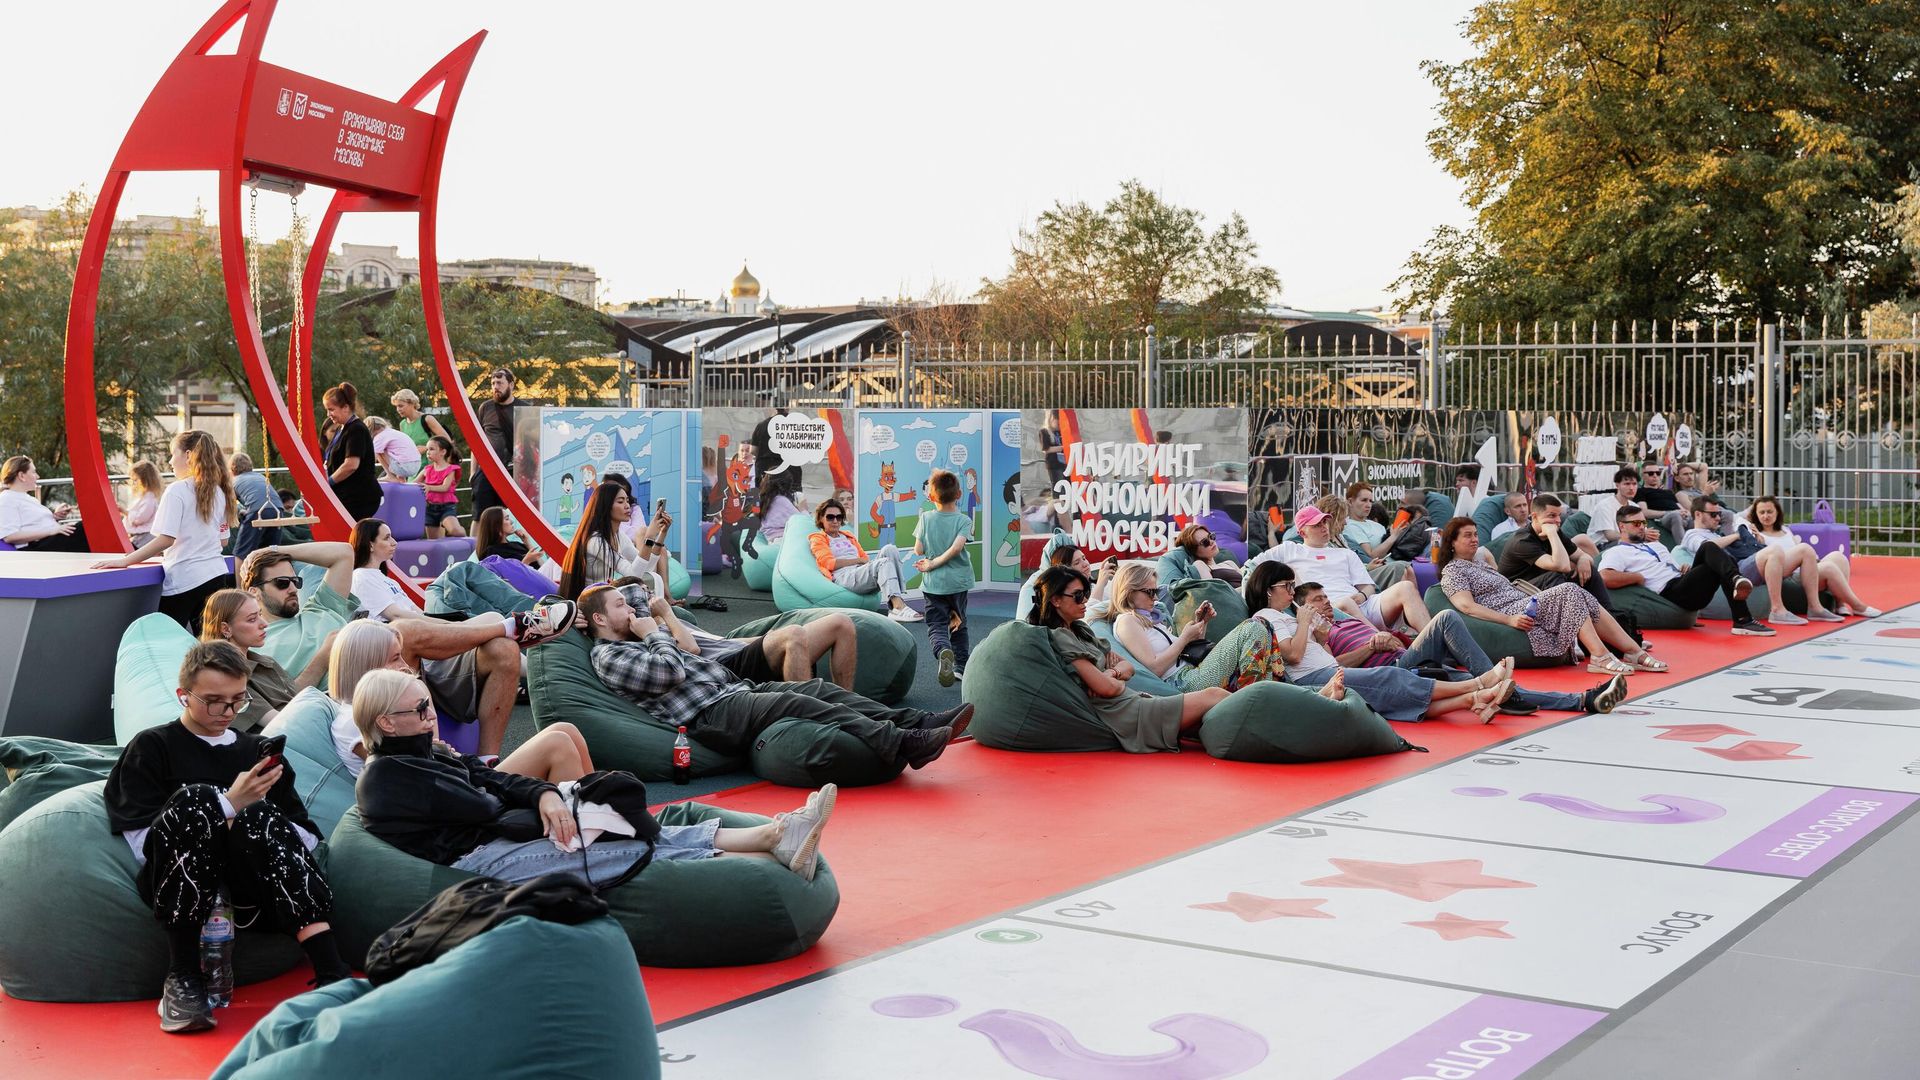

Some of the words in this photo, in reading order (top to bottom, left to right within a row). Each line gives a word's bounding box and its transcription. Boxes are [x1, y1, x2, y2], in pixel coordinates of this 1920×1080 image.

[342, 111, 387, 136] ПРОКАЧИВАЮ
[387, 124, 406, 141] СЕБЯ
[337, 128, 345, 144] В
[345, 131, 386, 154] ЭКОНОМИКЕ
[333, 146, 365, 167] МОСКВЫ
[775, 423, 780, 431] В
[781, 424, 825, 432] ПУТЕШЕСТВИЕ
[775, 432, 785, 440] ПО
[786, 433, 825, 441] ЛАБИРИНТУ
[779, 441, 822, 450] ЭКОНОМИКИ!
[1063, 441, 1203, 478] ЛАБИРИНТ
[1368, 463, 1422, 480] ЭКОНОМИКА
[1054, 479, 1212, 518] ЭКОНОМИКИ
[1372, 485, 1405, 501] ОСКВЫ
[1765, 799, 1883, 861] ВОПРОС-ОТВЕТ
[1054, 900, 1116, 918] 40
[1620, 911, 1714, 954] БОНУС
[1400, 1027, 1533, 1080] ВОПР
